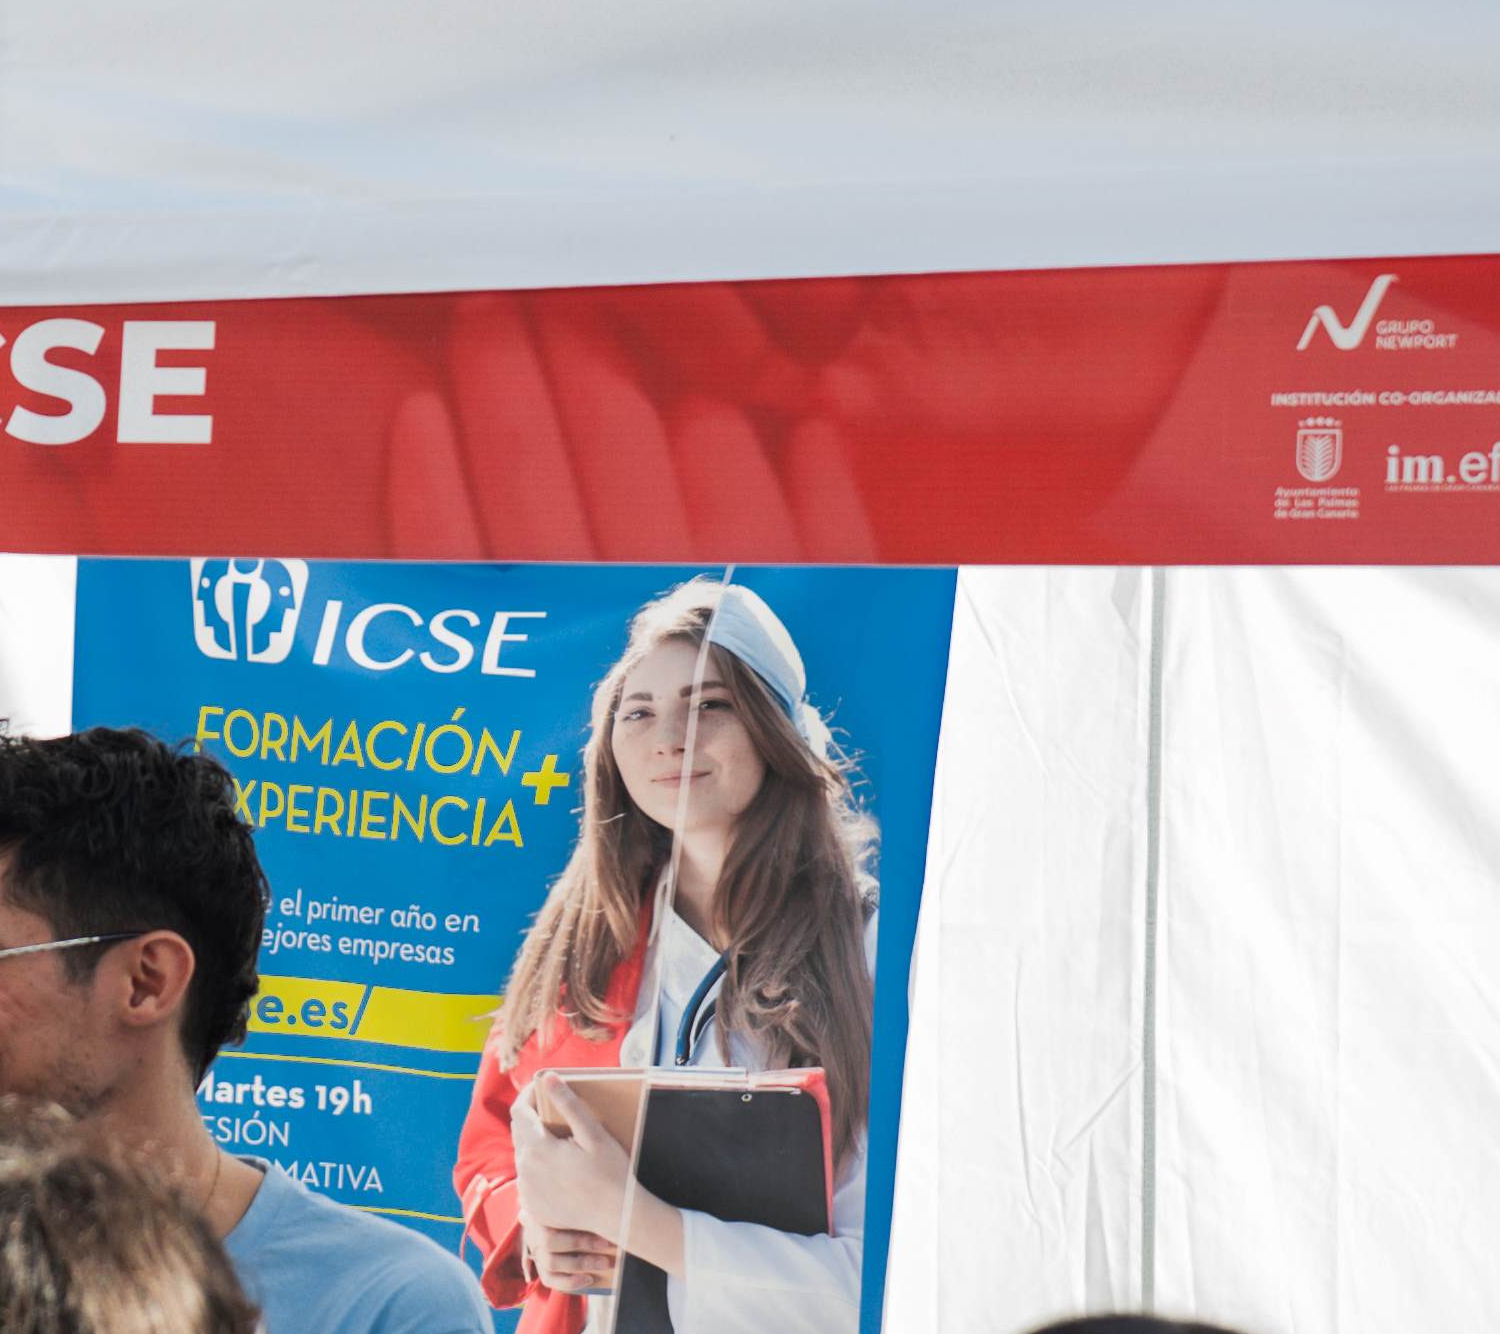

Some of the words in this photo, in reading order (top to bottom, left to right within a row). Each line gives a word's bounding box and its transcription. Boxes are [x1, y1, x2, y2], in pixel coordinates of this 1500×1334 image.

[1376, 320, 1434, 334] GRUPO
[1376, 334, 1457, 350] NEWPORT
[1271, 389, 1376, 407] INSTITUCIÓN
[312, 600, 547, 678] ICSE
[194, 706, 520, 775] FORMACIÓN
[233, 778, 524, 848] XPERIENCIA
[280, 889, 303, 916] el
[307, 896, 385, 925] primer
[391, 905, 437, 931] año
[445, 914, 481, 933] en
[262, 923, 332, 954] ejores
[338, 936, 455, 965] empresas
[195, 1070, 305, 1109] Martes
[315, 1079, 373, 1115] 19h
[273, 1158, 384, 1194] MATIVA
